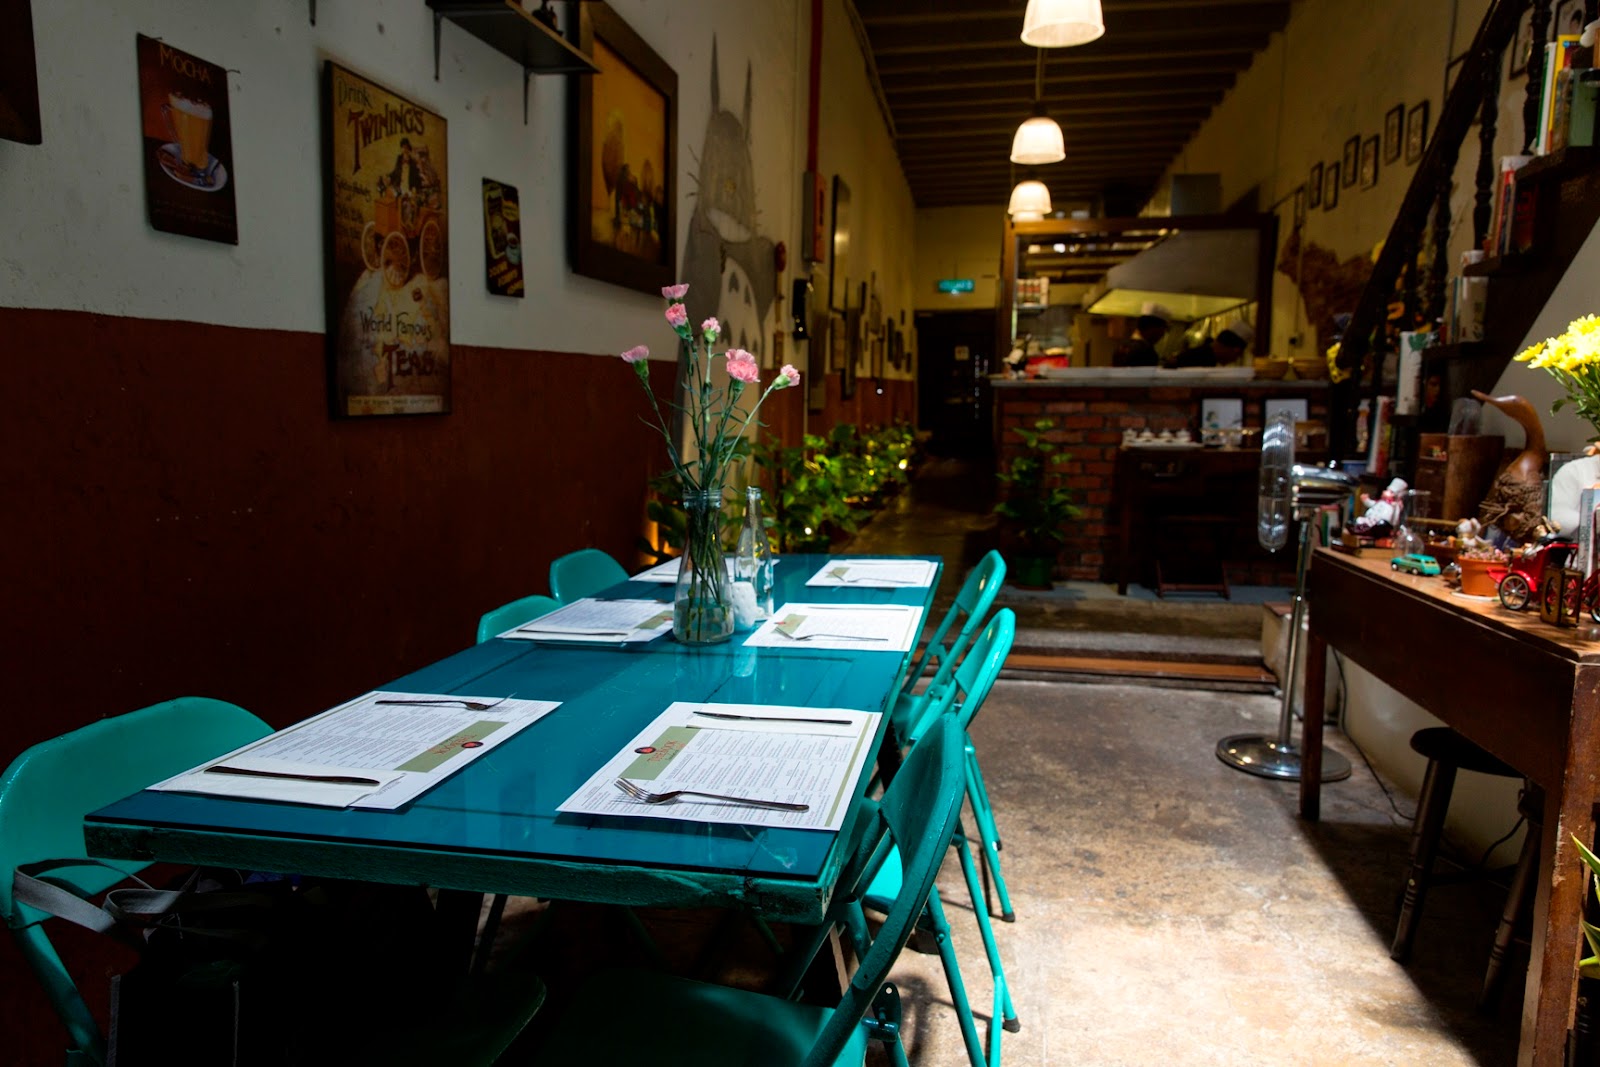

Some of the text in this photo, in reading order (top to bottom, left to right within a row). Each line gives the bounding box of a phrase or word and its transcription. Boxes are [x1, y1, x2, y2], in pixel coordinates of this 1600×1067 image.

[159, 44, 211, 84] MOCHA
[336, 77, 372, 108] Drink
[360, 308, 432, 341] World Famous
